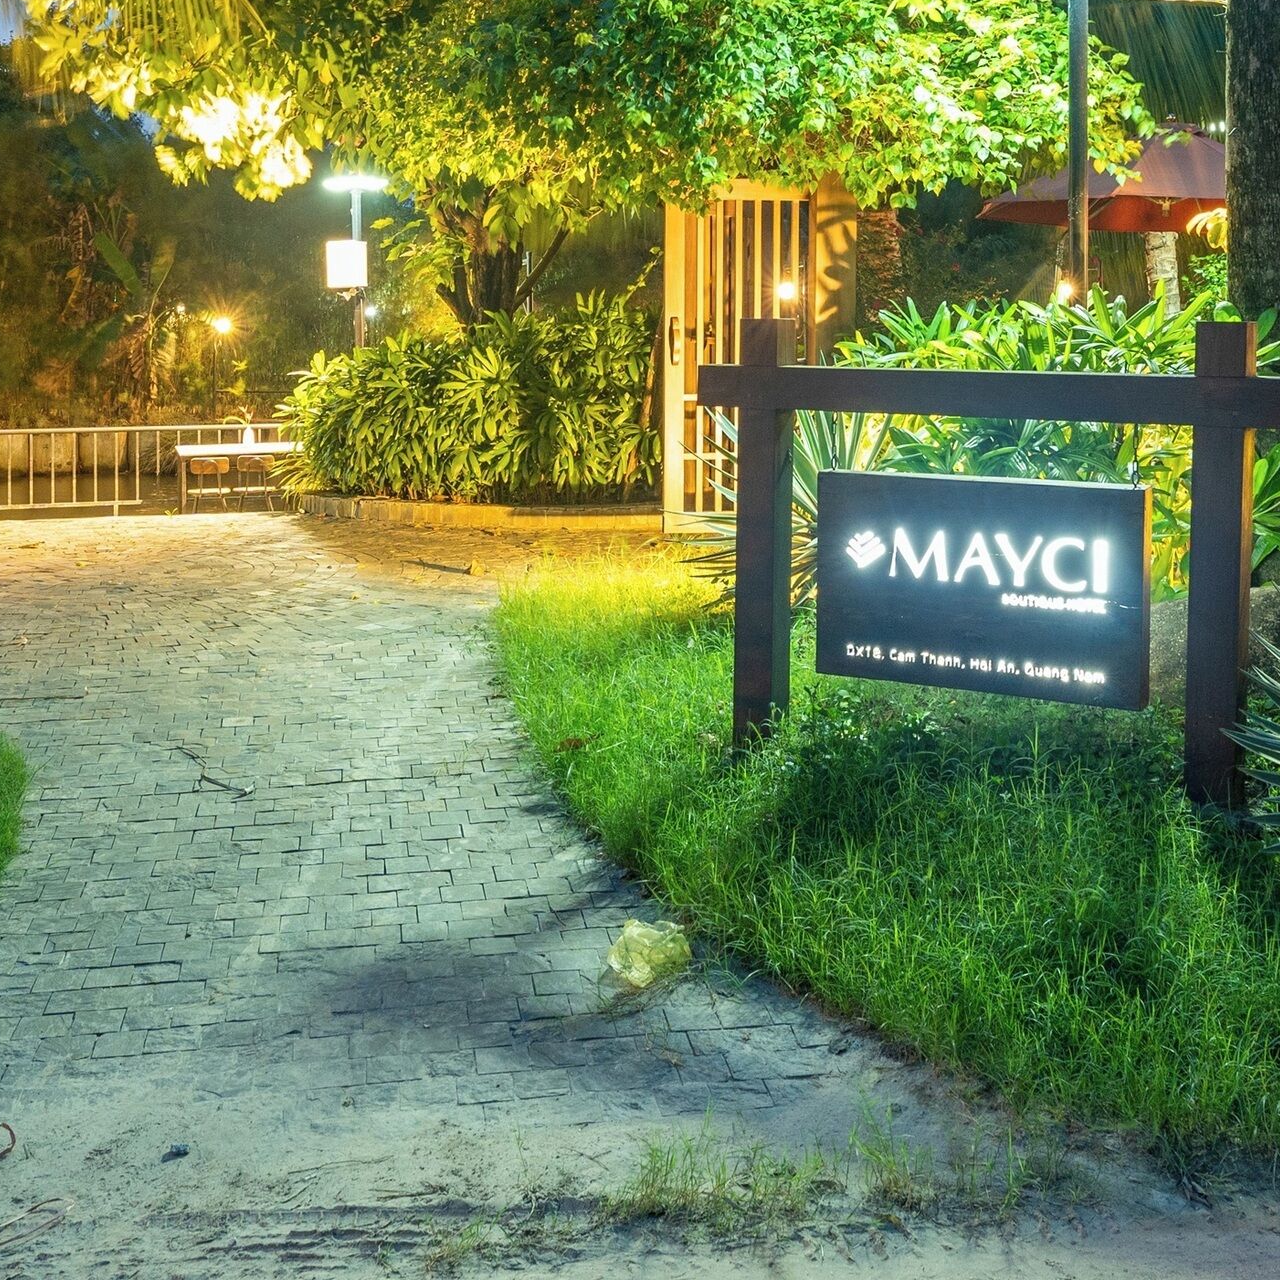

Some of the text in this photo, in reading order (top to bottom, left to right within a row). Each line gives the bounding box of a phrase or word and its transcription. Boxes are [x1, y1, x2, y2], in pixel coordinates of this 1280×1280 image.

[888, 526, 1111, 594] MAYCI
[889, 648, 916, 663] Cam
[920, 652, 966, 669] Thanh,
[996, 660, 1020, 675] An,
[1024, 662, 1069, 682] Quang
